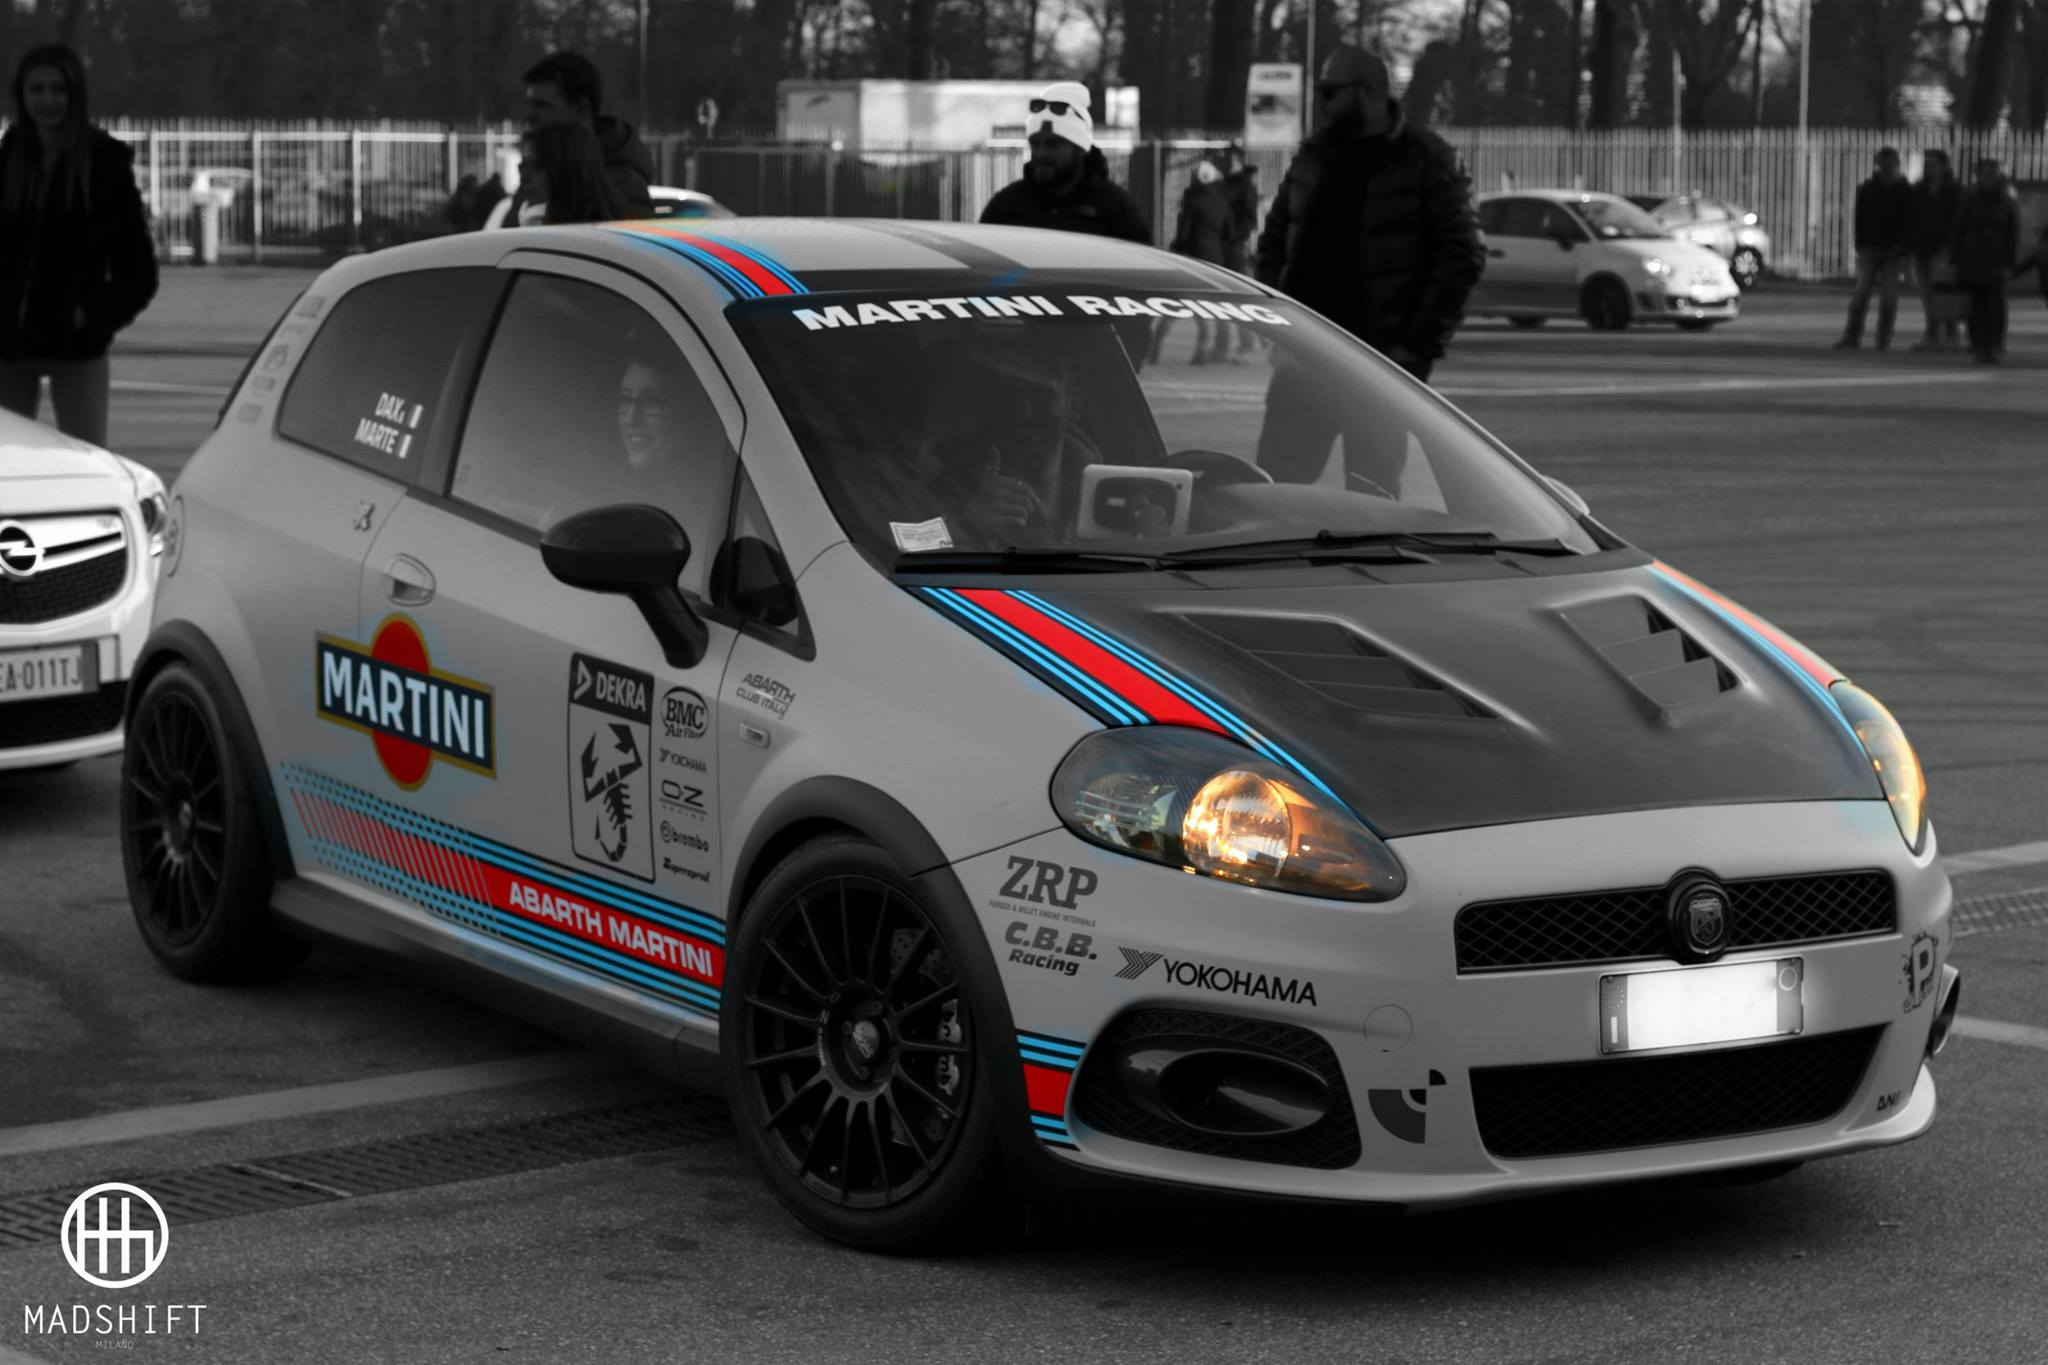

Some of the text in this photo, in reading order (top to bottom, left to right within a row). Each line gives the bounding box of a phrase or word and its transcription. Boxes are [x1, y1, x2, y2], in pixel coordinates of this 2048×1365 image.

[792, 296, 1292, 331] MARTINI RACING
[354, 418, 399, 454] MARTE
[323, 650, 485, 759] MARTINI
[595, 670, 647, 712] DEKRA
[741, 672, 796, 703] ABARTH
[665, 697, 705, 730] BMC
[671, 827, 709, 852] brembo
[999, 855, 1098, 910] ZRP
[509, 881, 714, 977] ABARTH MARTINI
[1005, 921, 1097, 960] C.B.B.
[1009, 948, 1080, 976] Racing
[1163, 958, 1318, 1007] YOKOHAMA
